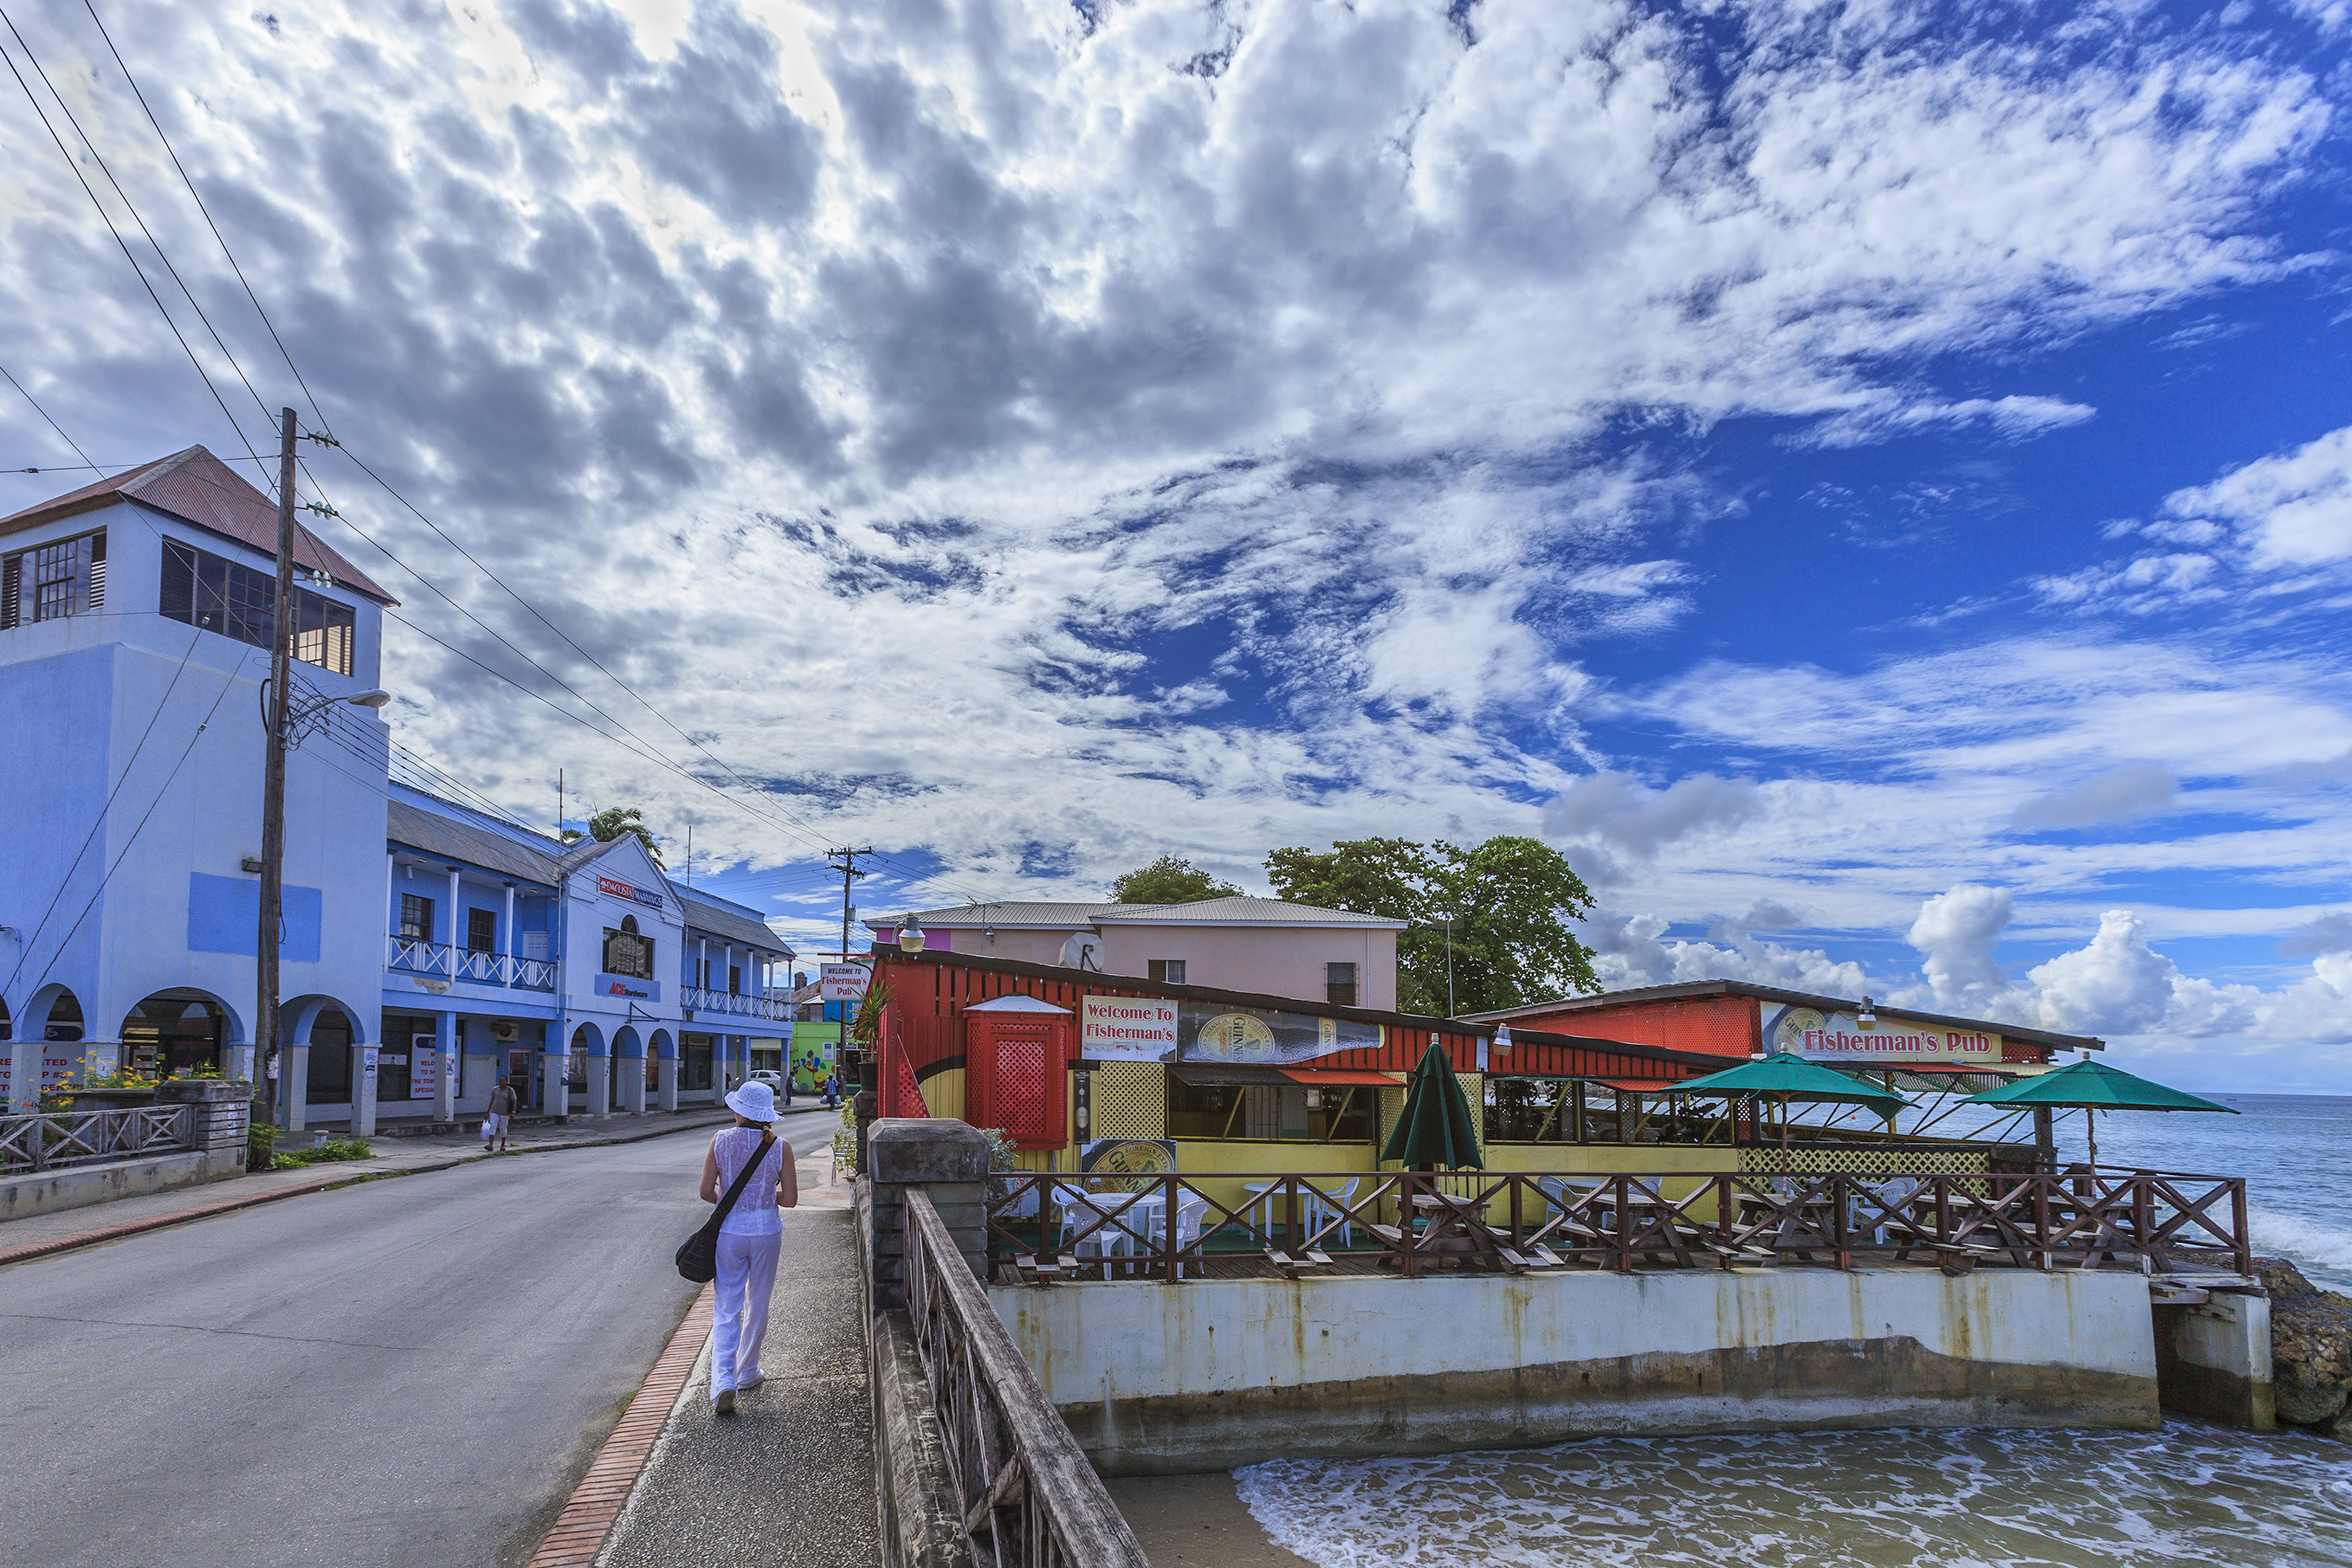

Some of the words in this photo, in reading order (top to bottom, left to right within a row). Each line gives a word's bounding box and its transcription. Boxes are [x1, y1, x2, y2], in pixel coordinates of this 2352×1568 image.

[607, 882, 632, 897] DACOSTA
[635, 890, 662, 906] MANNINGS
[609, 981, 626, 995] ACE
[624, 989, 648, 997] Hardware
[822, 976, 867, 985] Fisherman's
[1087, 1003, 1153, 1020] Welcome
[1155, 1007, 1173, 1021] To
[1086, 1023, 1173, 1041] Fisherman's
[1805, 1029, 1938, 1052] Fisherman's
[1946, 1032, 1990, 1052] Pub
